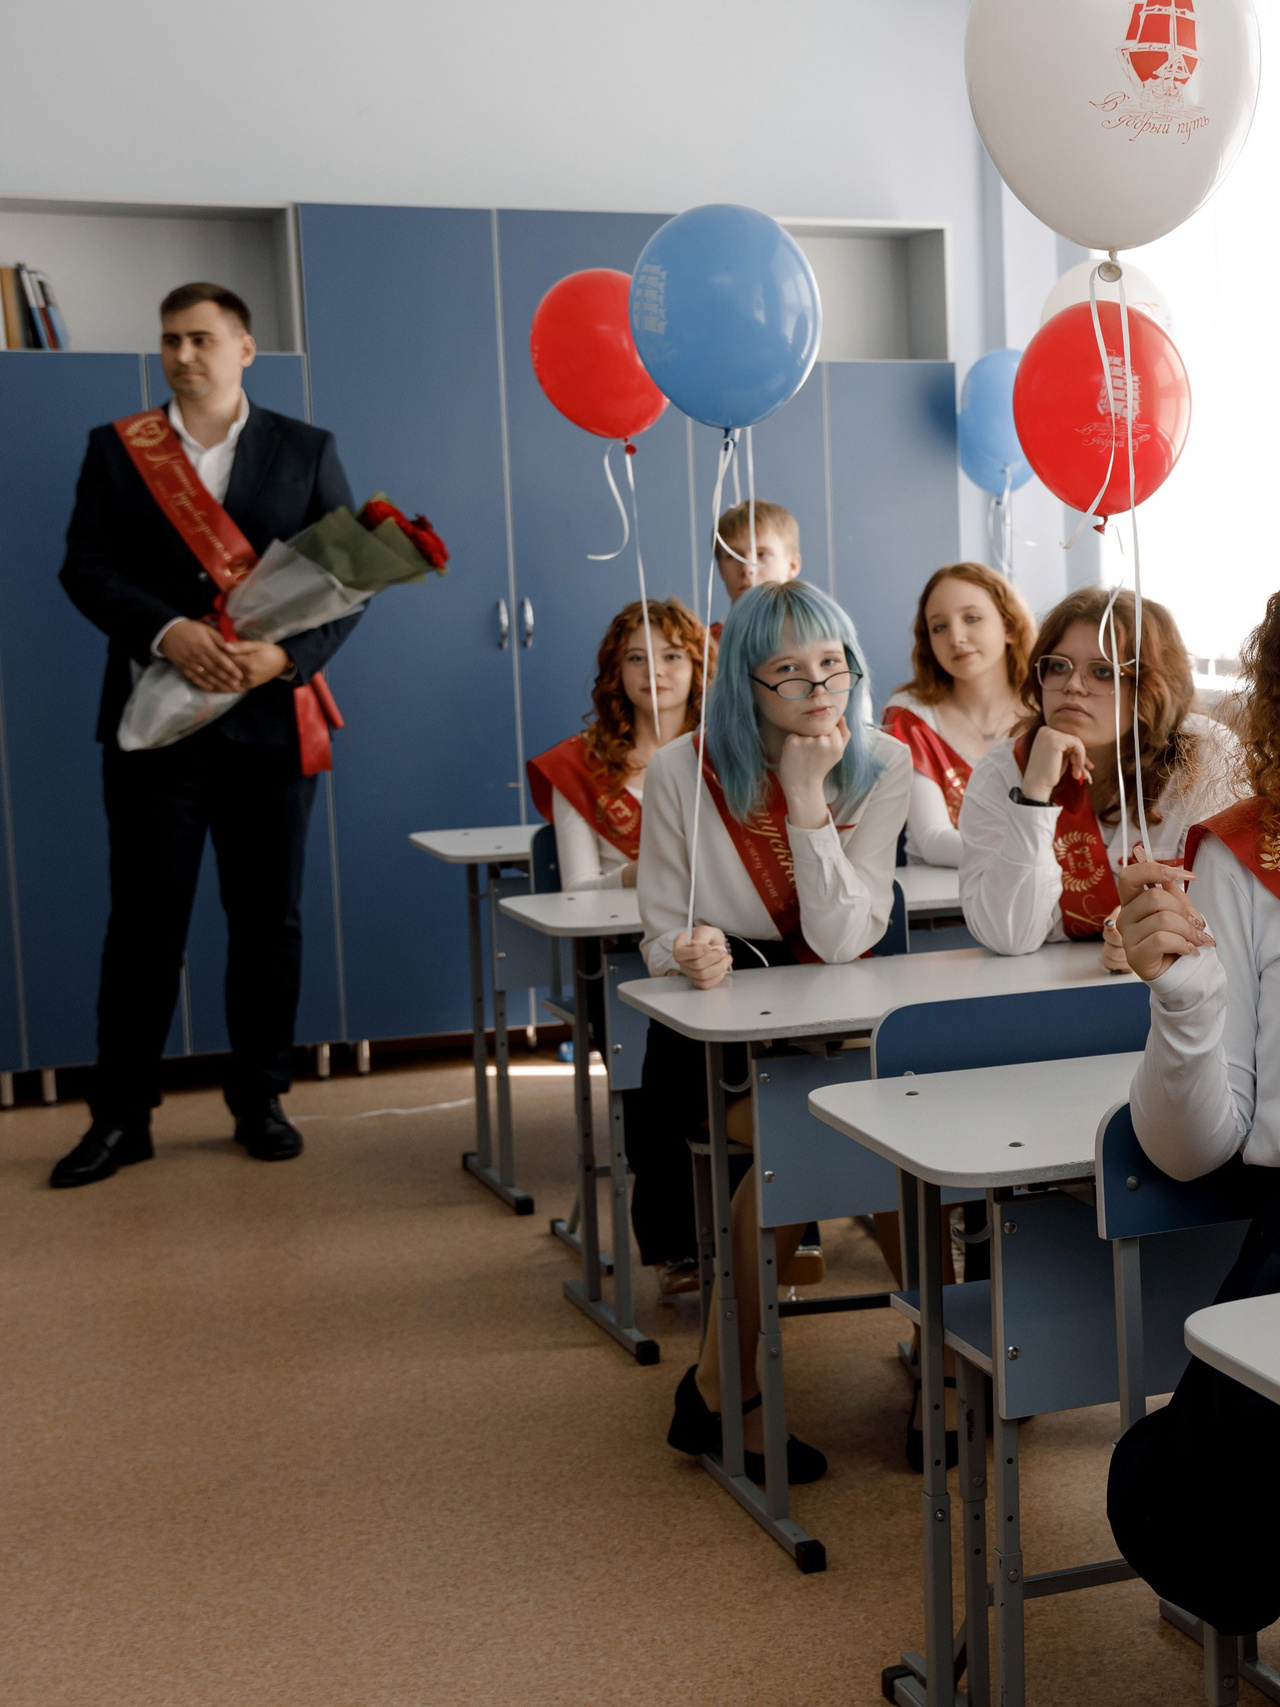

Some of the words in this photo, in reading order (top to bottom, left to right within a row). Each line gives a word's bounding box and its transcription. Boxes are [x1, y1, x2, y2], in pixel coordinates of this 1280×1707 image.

[1088, 91, 1130, 112] В
[1101, 111, 1173, 142] добрый
[1176, 115, 1210, 145] путь
